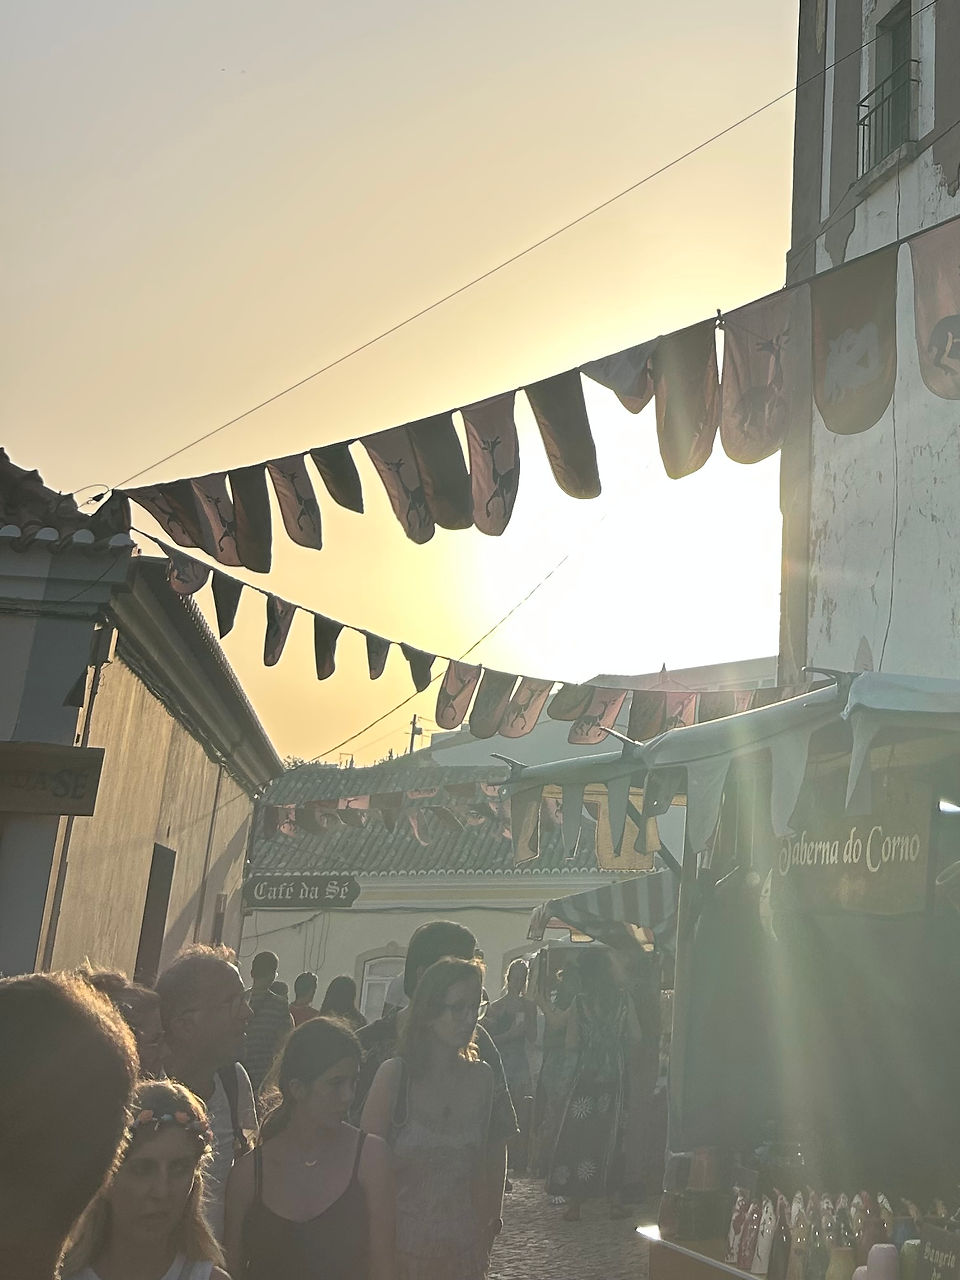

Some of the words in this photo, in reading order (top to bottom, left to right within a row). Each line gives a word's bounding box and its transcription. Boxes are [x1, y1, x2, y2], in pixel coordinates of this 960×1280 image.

[843, 826, 862, 864] do
[866, 825, 920, 872] Corno
[254, 881, 294, 900] Café
[299, 881, 319, 899] da
[325, 880, 349, 899] Sé
[924, 1241, 956, 1268] Sangria
